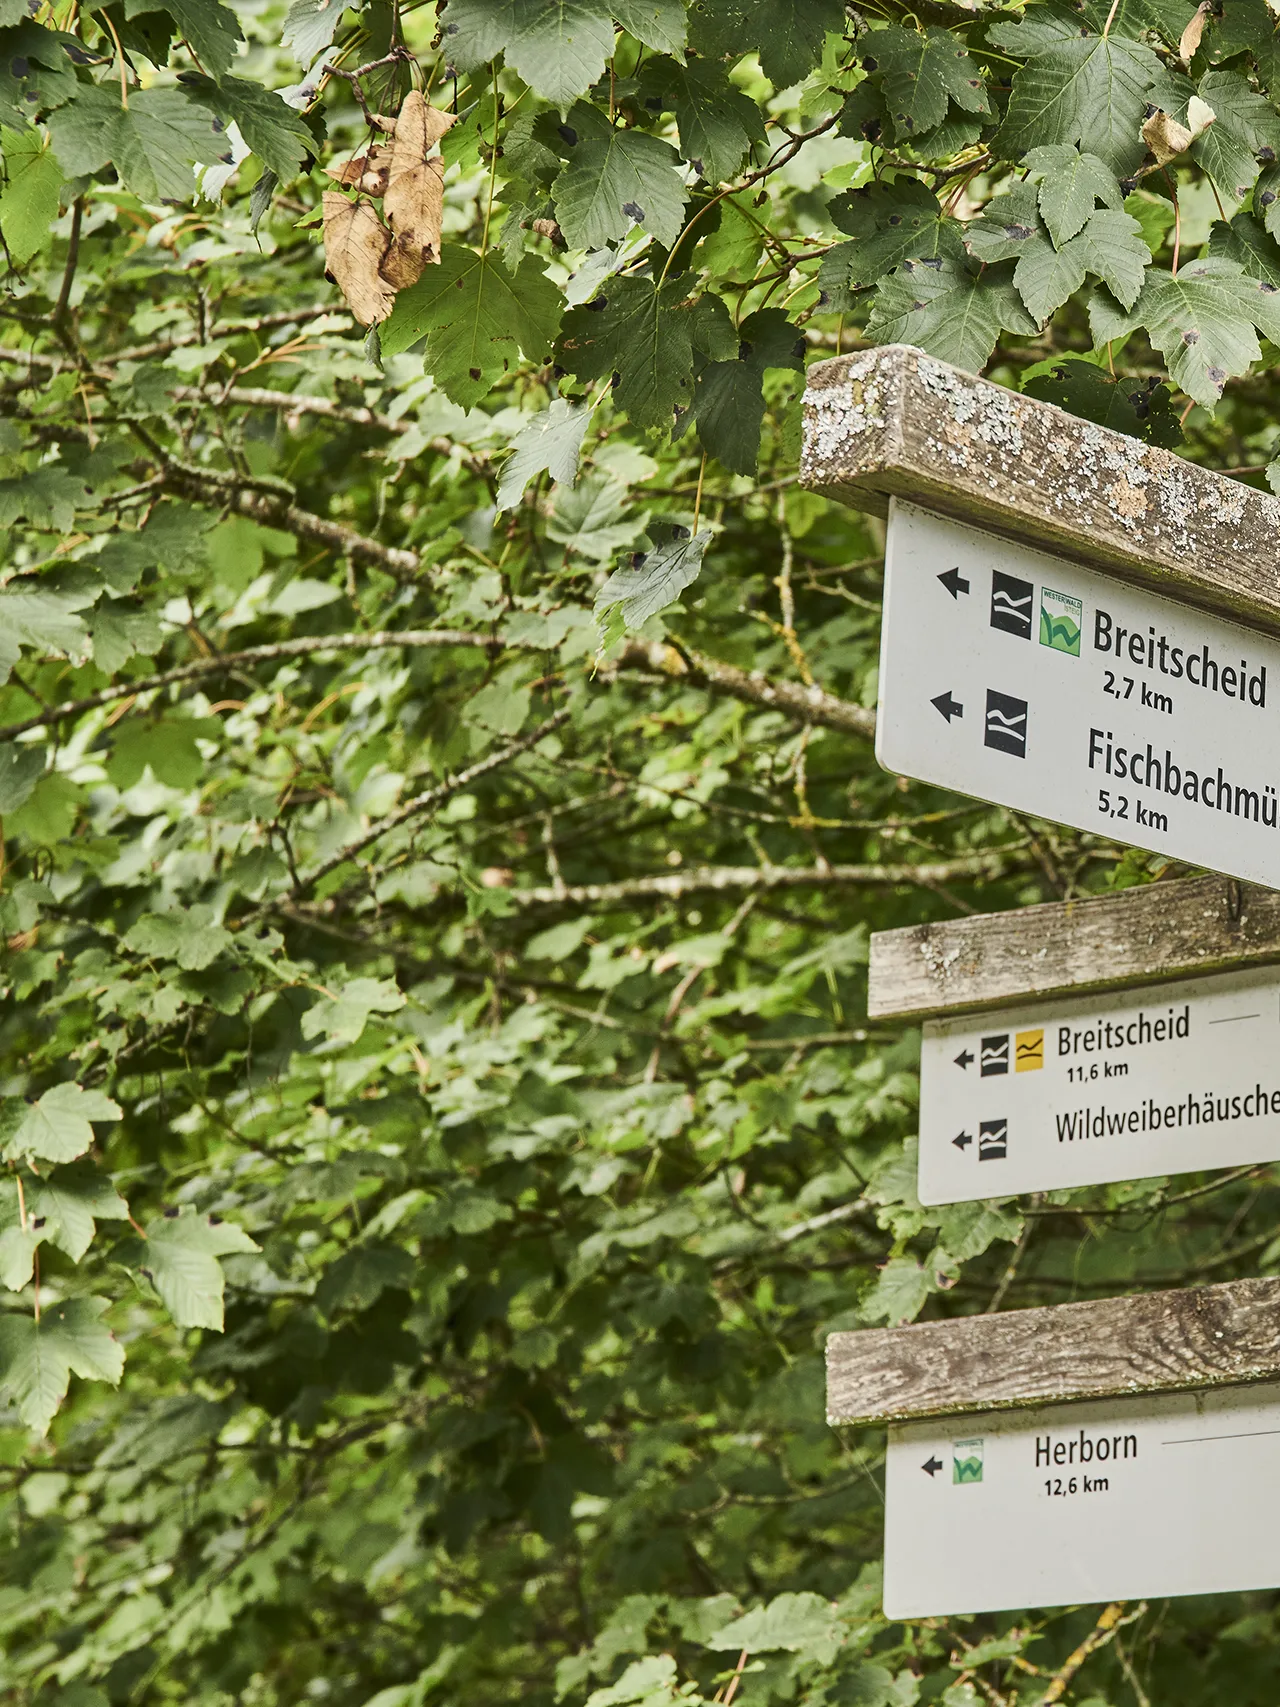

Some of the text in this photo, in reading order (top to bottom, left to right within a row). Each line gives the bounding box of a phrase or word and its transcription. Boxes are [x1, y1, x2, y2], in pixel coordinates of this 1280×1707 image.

[1043, 590, 1081, 608] WESTERWALD
[1094, 609, 1266, 708] Breitscheid
[1104, 671, 1172, 714] 2,7 km
[1099, 790, 1167, 832] 5,2 km
[1059, 1006, 1189, 1055] Breitscheid
[1068, 1062, 1128, 1082] 11,6 km
[1036, 1430, 1136, 1467] Herborn
[1045, 1476, 1108, 1496] 12,6 km
